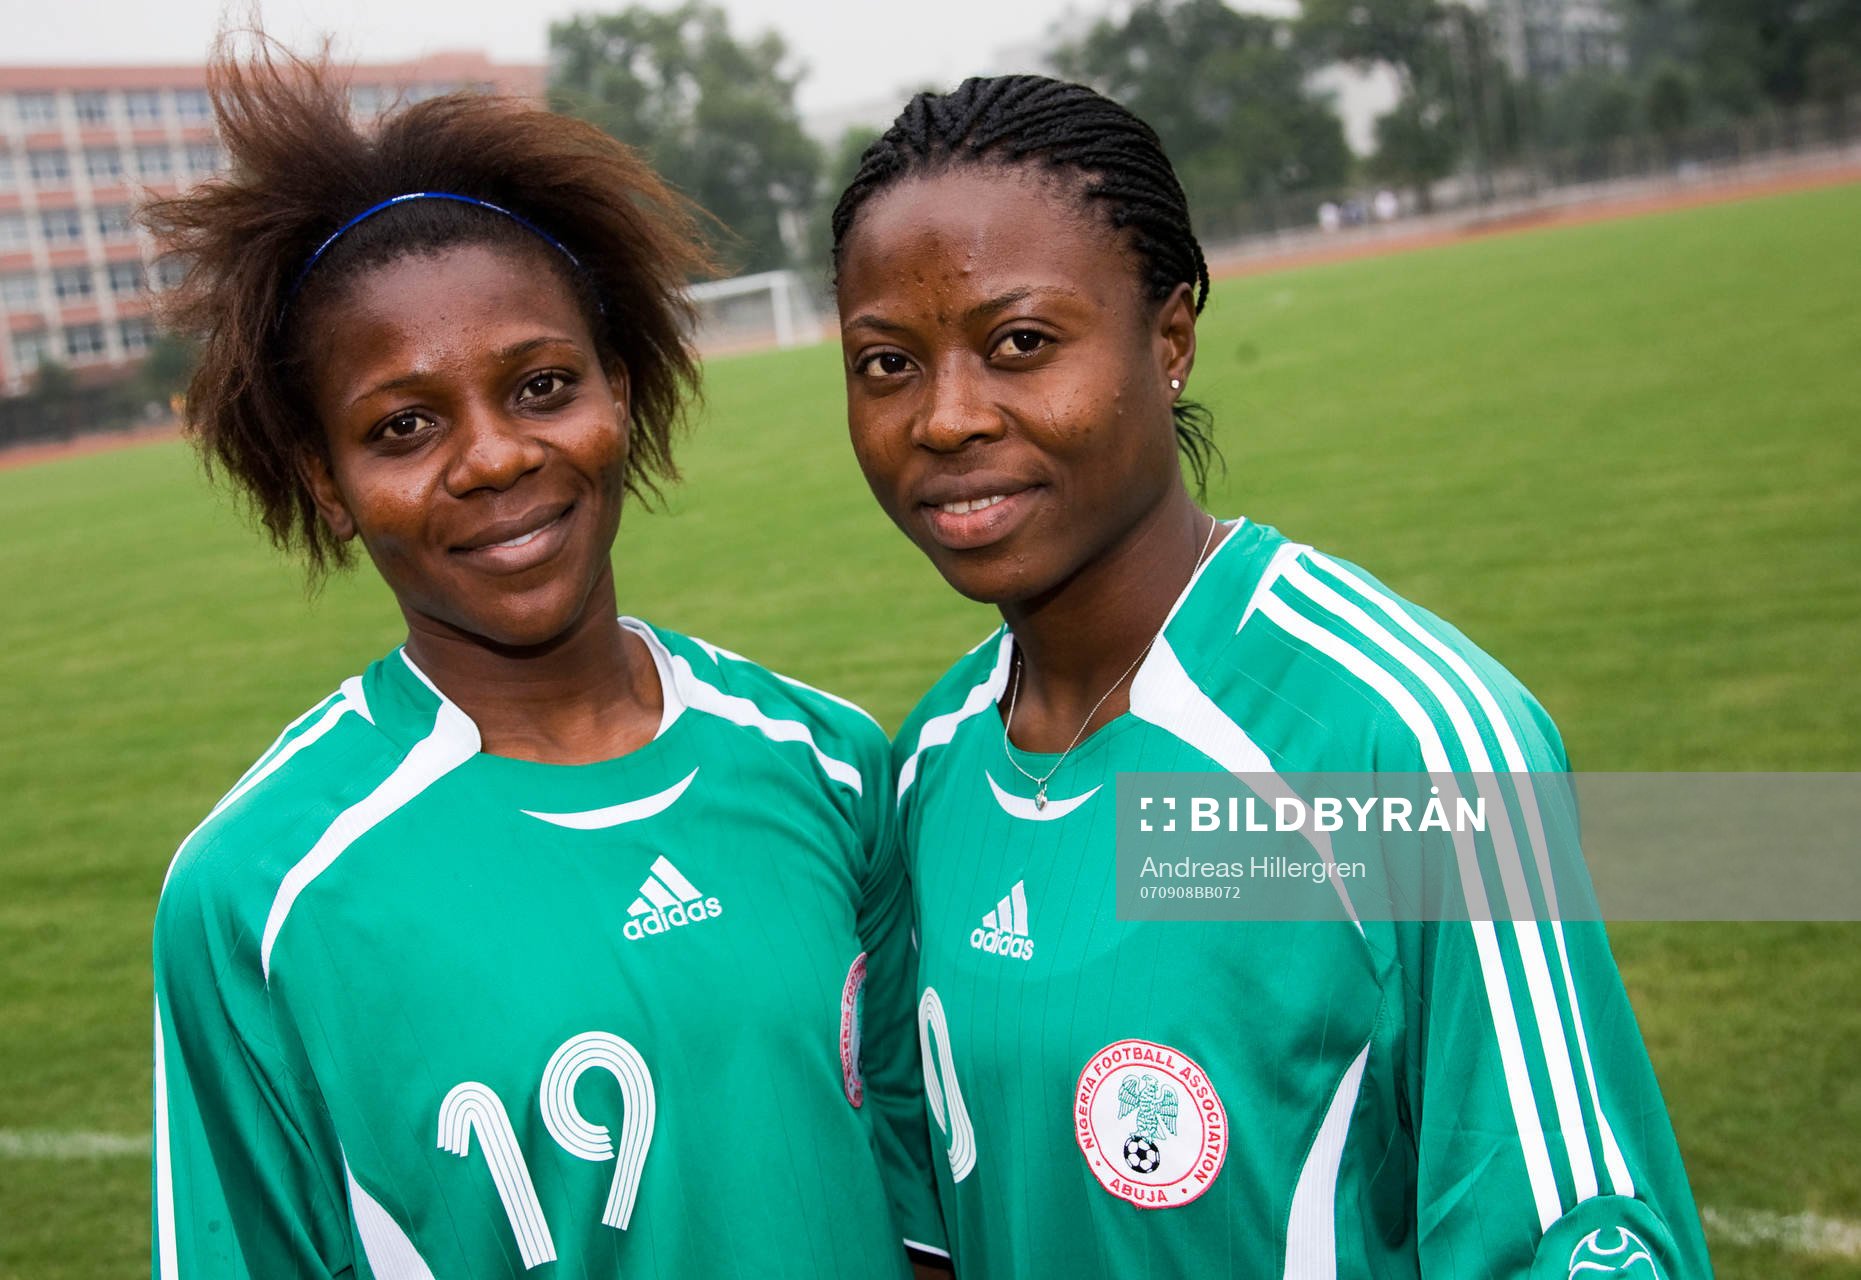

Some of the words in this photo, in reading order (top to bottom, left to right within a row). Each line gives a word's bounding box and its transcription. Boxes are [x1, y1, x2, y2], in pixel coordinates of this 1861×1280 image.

[622, 896, 723, 940] adidas
[970, 927, 1034, 961] adidas
[1078, 1077, 1097, 1149] NIGERIA
[1094, 1047, 1176, 1076] FOOTBALL
[1179, 1066, 1221, 1184] ASSOCIATION
[437, 1031, 656, 1270] 19
[1109, 1178, 1168, 1203] ABUJA
